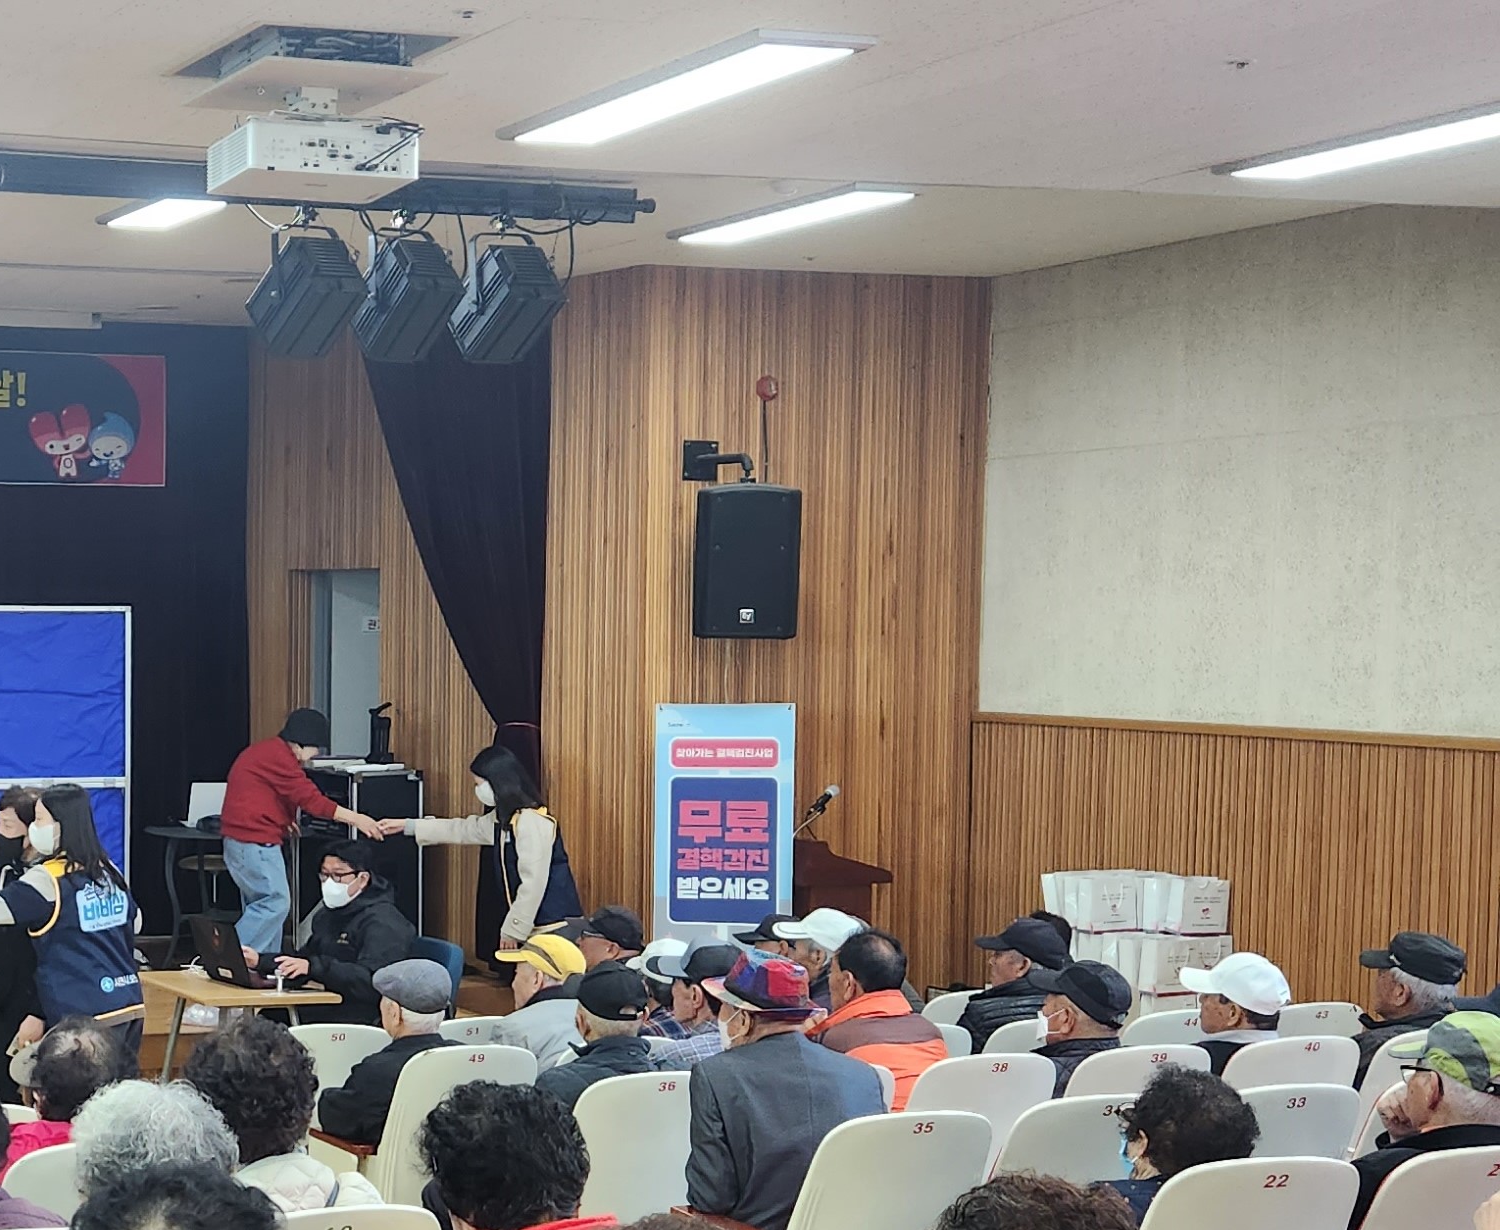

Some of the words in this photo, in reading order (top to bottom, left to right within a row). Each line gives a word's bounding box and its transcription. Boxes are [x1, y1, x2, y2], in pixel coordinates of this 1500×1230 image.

[678, 800, 769, 844] 무료
[677, 848, 769, 872] 결핵검진
[676, 877, 770, 900] 받으세요
[1315, 1011, 1328, 1019] 43
[331, 1033, 346, 1041] 50
[466, 1027, 479, 1036] 51
[1304, 1042, 1320, 1052] 40
[468, 1053, 485, 1063] 49
[1151, 1053, 1167, 1063] 39
[991, 1062, 1008, 1073] 38
[659, 1081, 676, 1092] 36
[1287, 1097, 1307, 1109] 33
[913, 1122, 934, 1135] 35
[1263, 1174, 1289, 1188] 22
